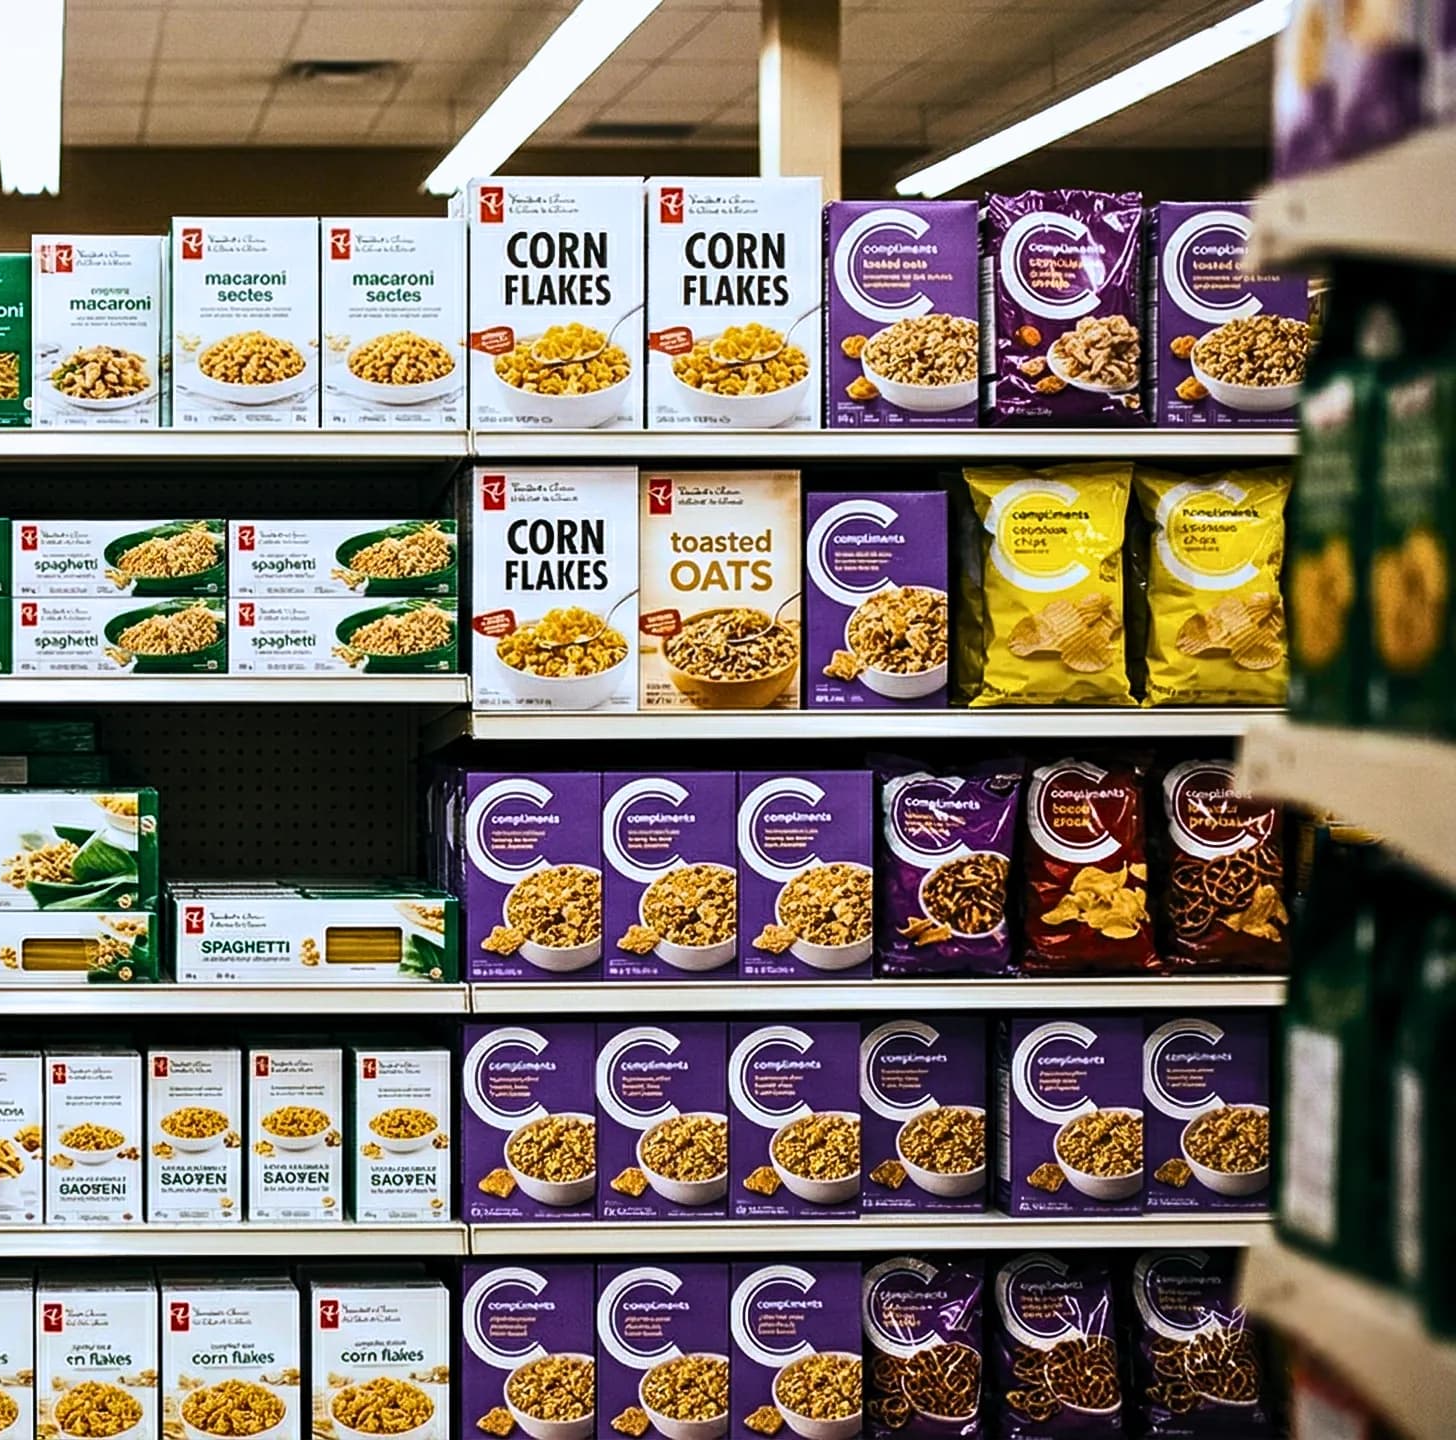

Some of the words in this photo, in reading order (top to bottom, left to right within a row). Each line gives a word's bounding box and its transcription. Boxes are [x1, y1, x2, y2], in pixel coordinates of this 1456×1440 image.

[507, 232, 608, 269] CORN
[685, 232, 786, 269] CORN
[862, 242, 938, 257] compliments
[1029, 242, 1106, 257] compliments
[1192, 242, 1250, 257] complim
[205, 270, 287, 286] macaroni
[352, 270, 435, 286] macaroni
[505, 275, 611, 306] FLAKES
[684, 275, 790, 307] FLAKES
[69, 296, 152, 312] macaroni
[1012, 508, 1090, 521] compliments
[507, 519, 605, 555] CORN
[671, 529, 772, 554] toasted
[834, 533, 905, 546] compliments
[34, 557, 98, 573] spaghetti
[251, 557, 316, 573] spaghetti
[505, 559, 608, 591] FLAKES
[670, 560, 773, 592] OATS
[34, 634, 99, 649] spaghetti
[251, 634, 317, 650] spaghetti
[1051, 787, 1124, 800] compliments
[904, 797, 981, 811] compliments
[491, 813, 560, 825] compliments
[627, 812, 696, 825] compliments
[763, 811, 832, 824] compliments
[201, 940, 290, 954] SPAGHETTI
[754, 1060, 821, 1071] compliments
[488, 1300, 555, 1312] compliments
[757, 1299, 823, 1311] compliments
[89, 1352, 132, 1366] flakes
[192, 1353, 228, 1365] corn
[233, 1350, 274, 1365] flakes
[341, 1351, 377, 1363] corn
[382, 1349, 424, 1363] flakes
